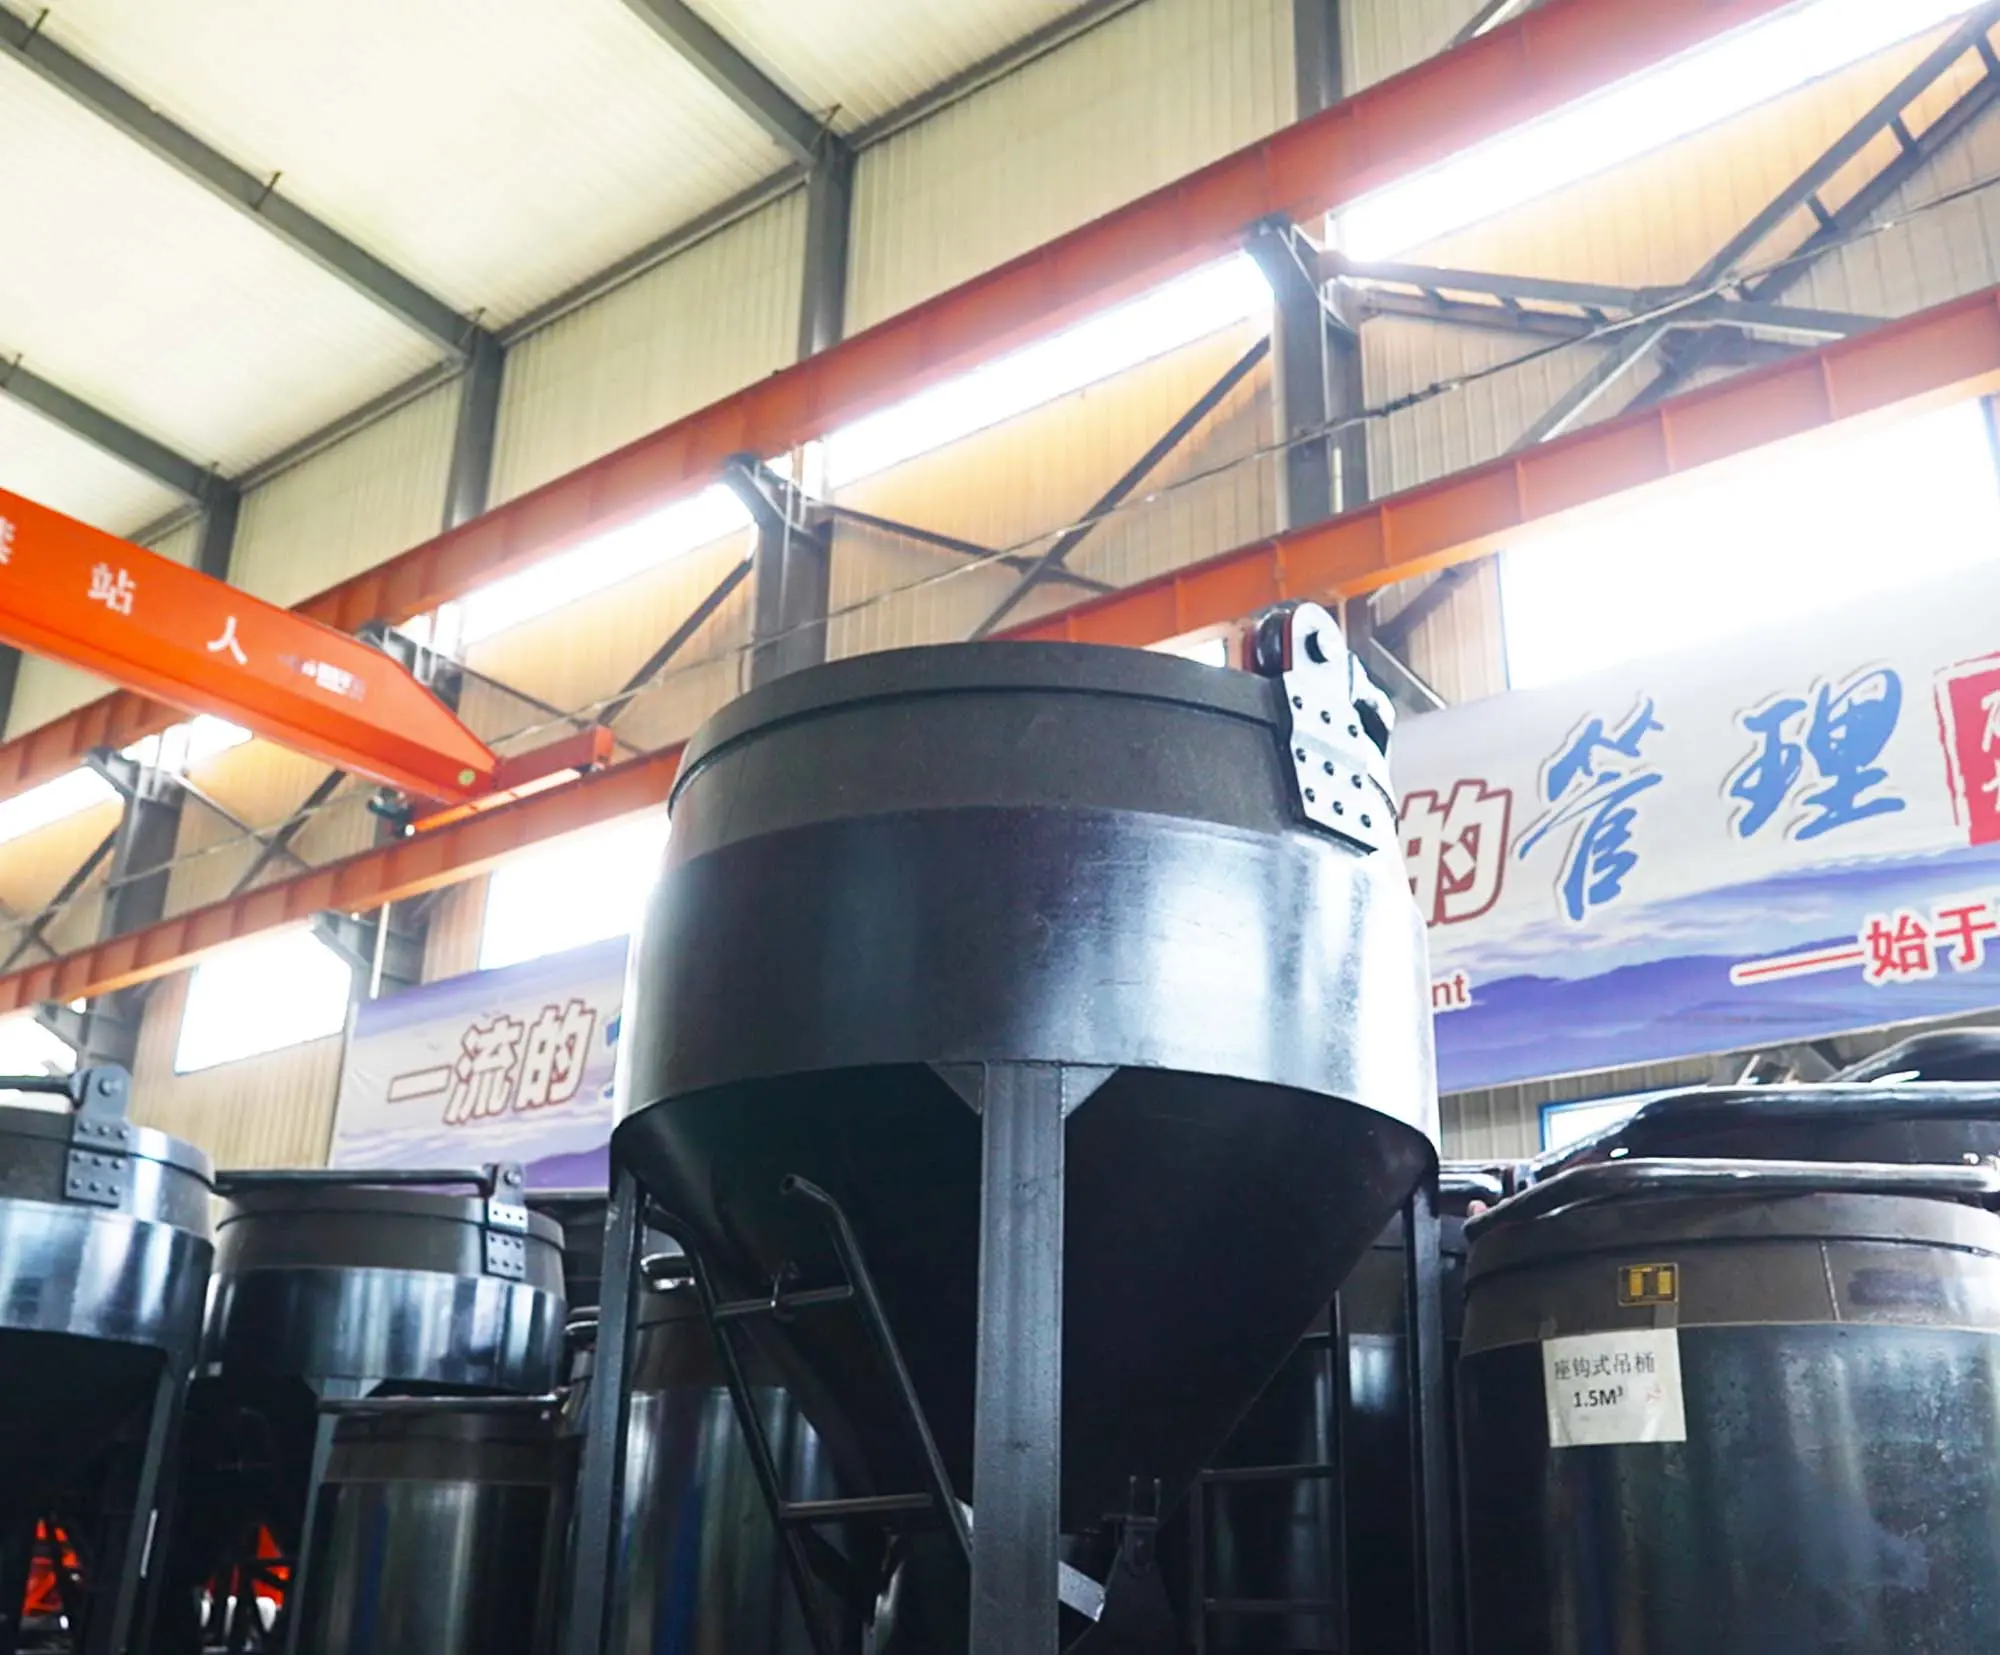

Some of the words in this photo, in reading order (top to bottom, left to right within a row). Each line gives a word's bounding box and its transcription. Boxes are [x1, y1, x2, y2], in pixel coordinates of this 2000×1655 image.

[1554, 1351, 1656, 1381] 座钩式吊桶
